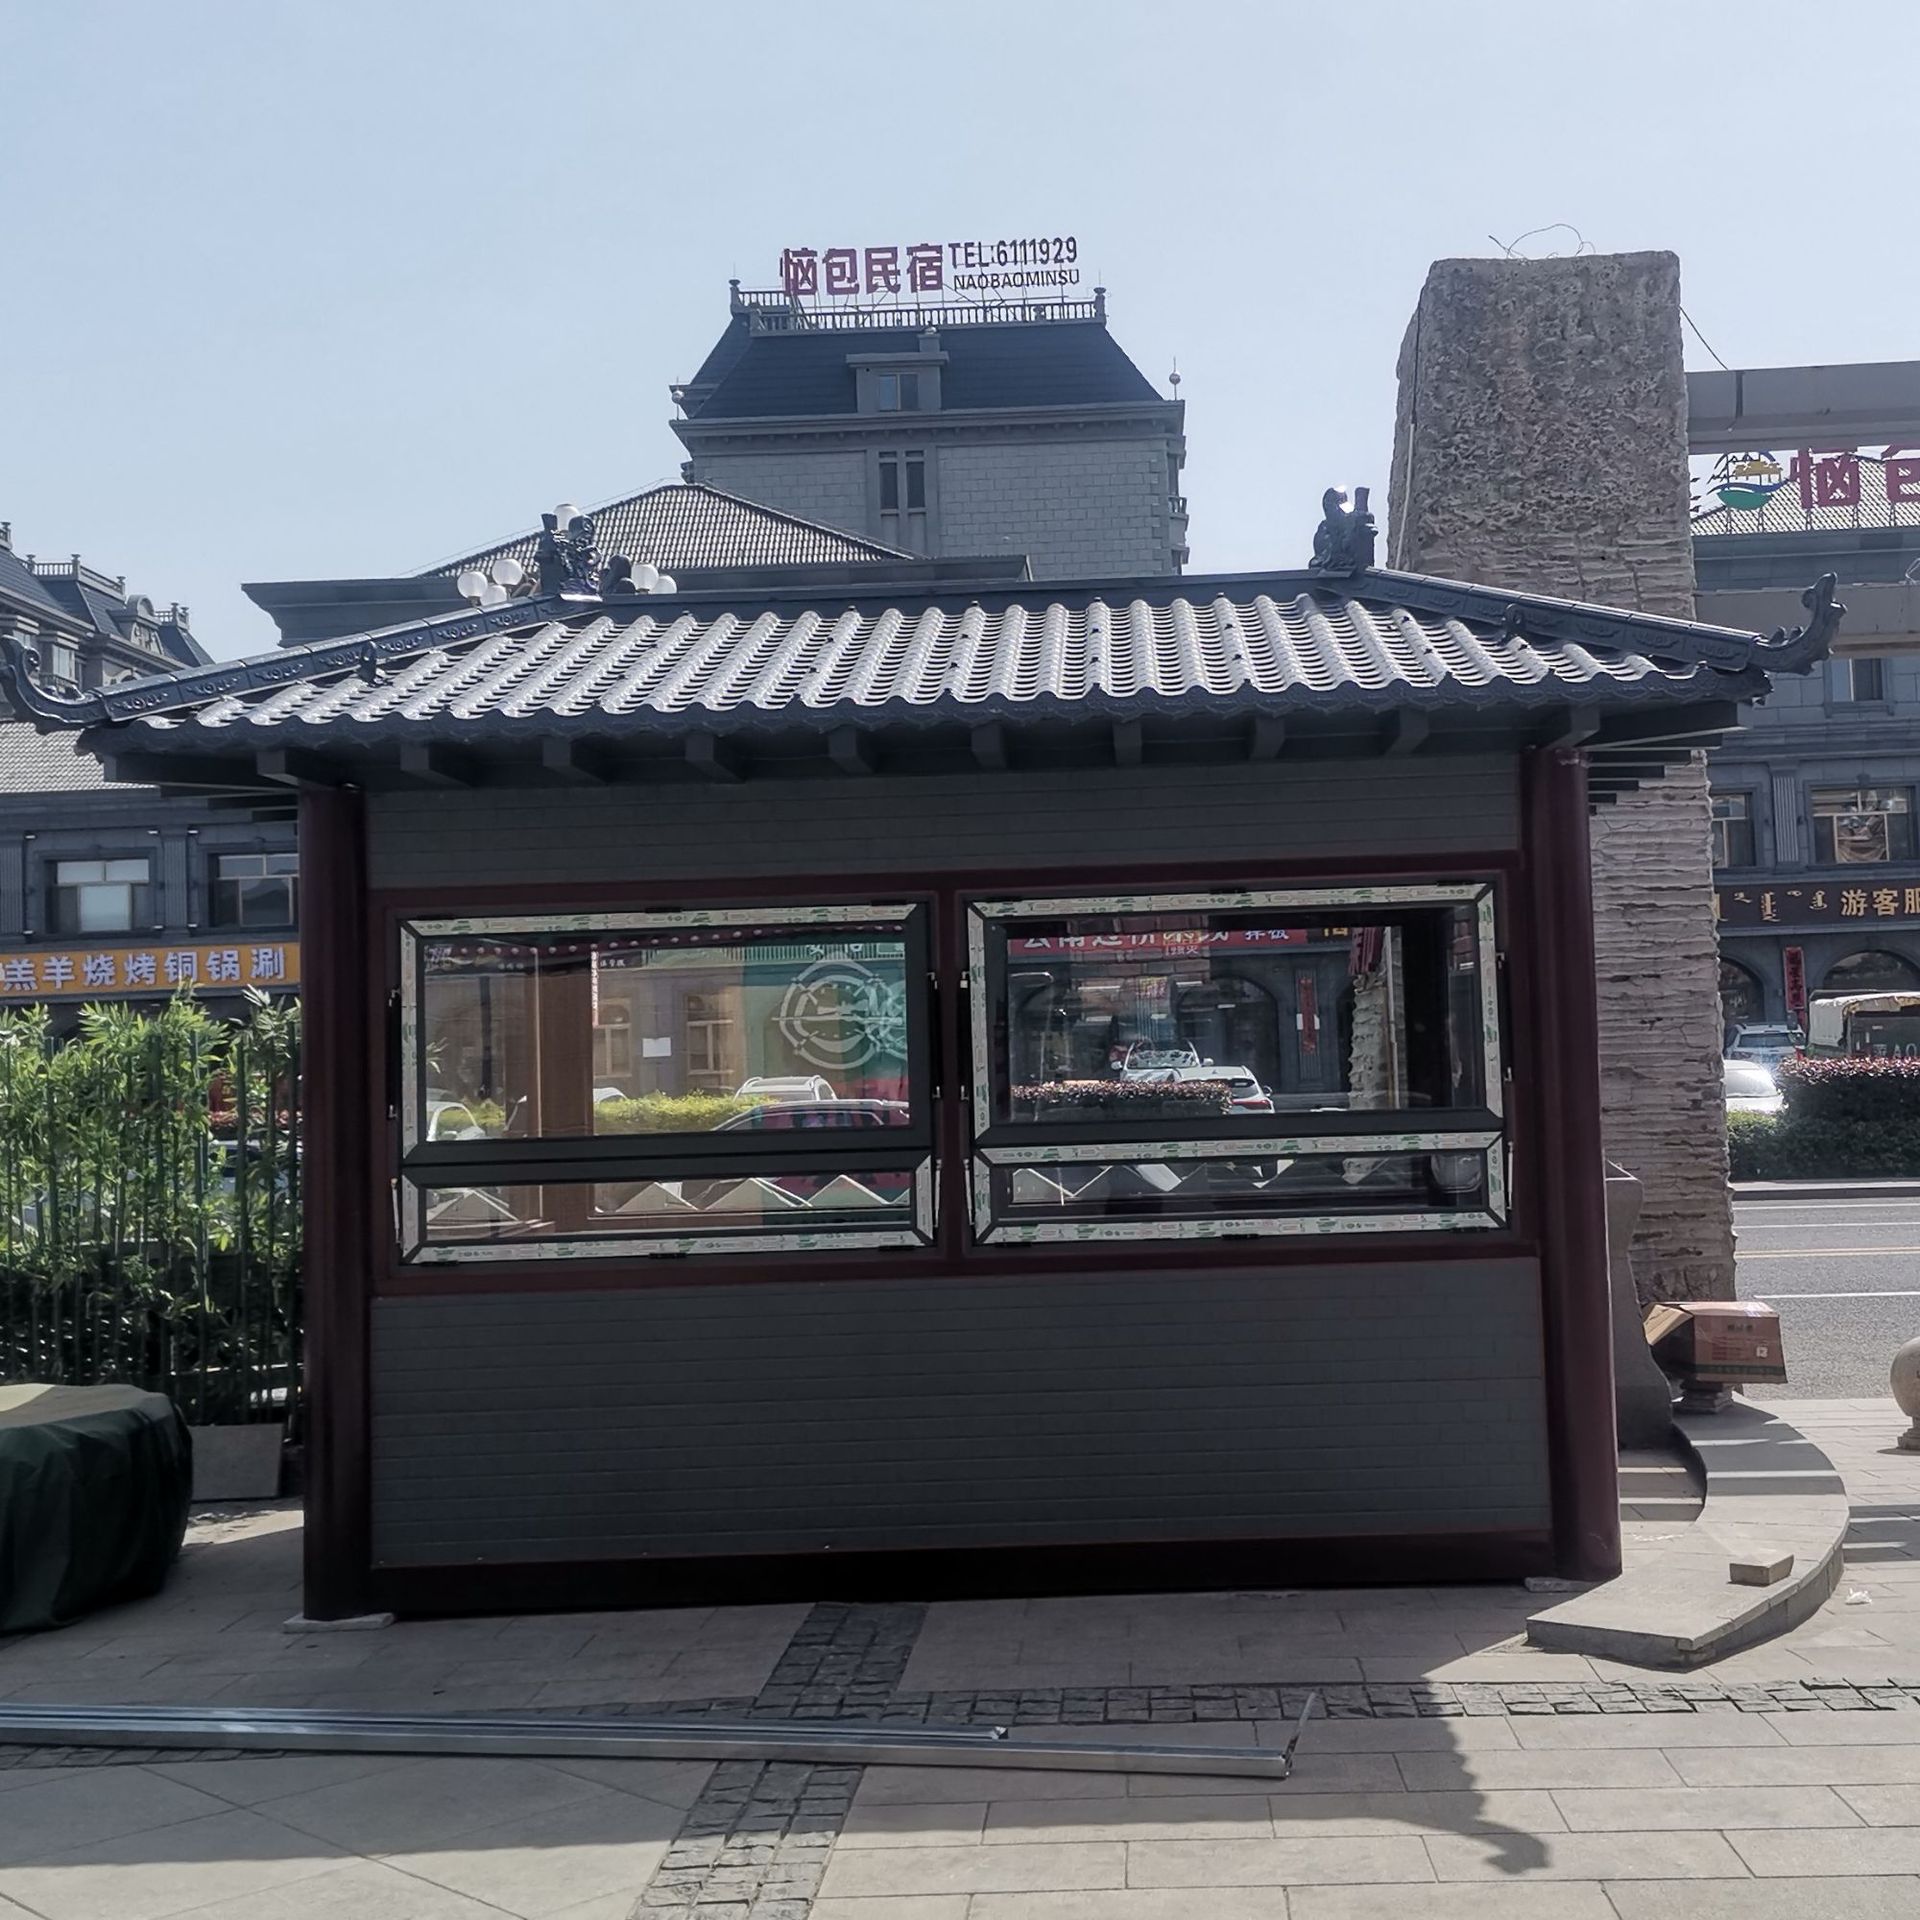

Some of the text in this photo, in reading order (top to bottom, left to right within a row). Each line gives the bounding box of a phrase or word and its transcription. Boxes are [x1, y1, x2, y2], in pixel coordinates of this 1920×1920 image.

[953, 269, 1080, 290] NAOBAOMINSU
[0, 946, 285, 991] 羔羊烧烤铜锅涮
